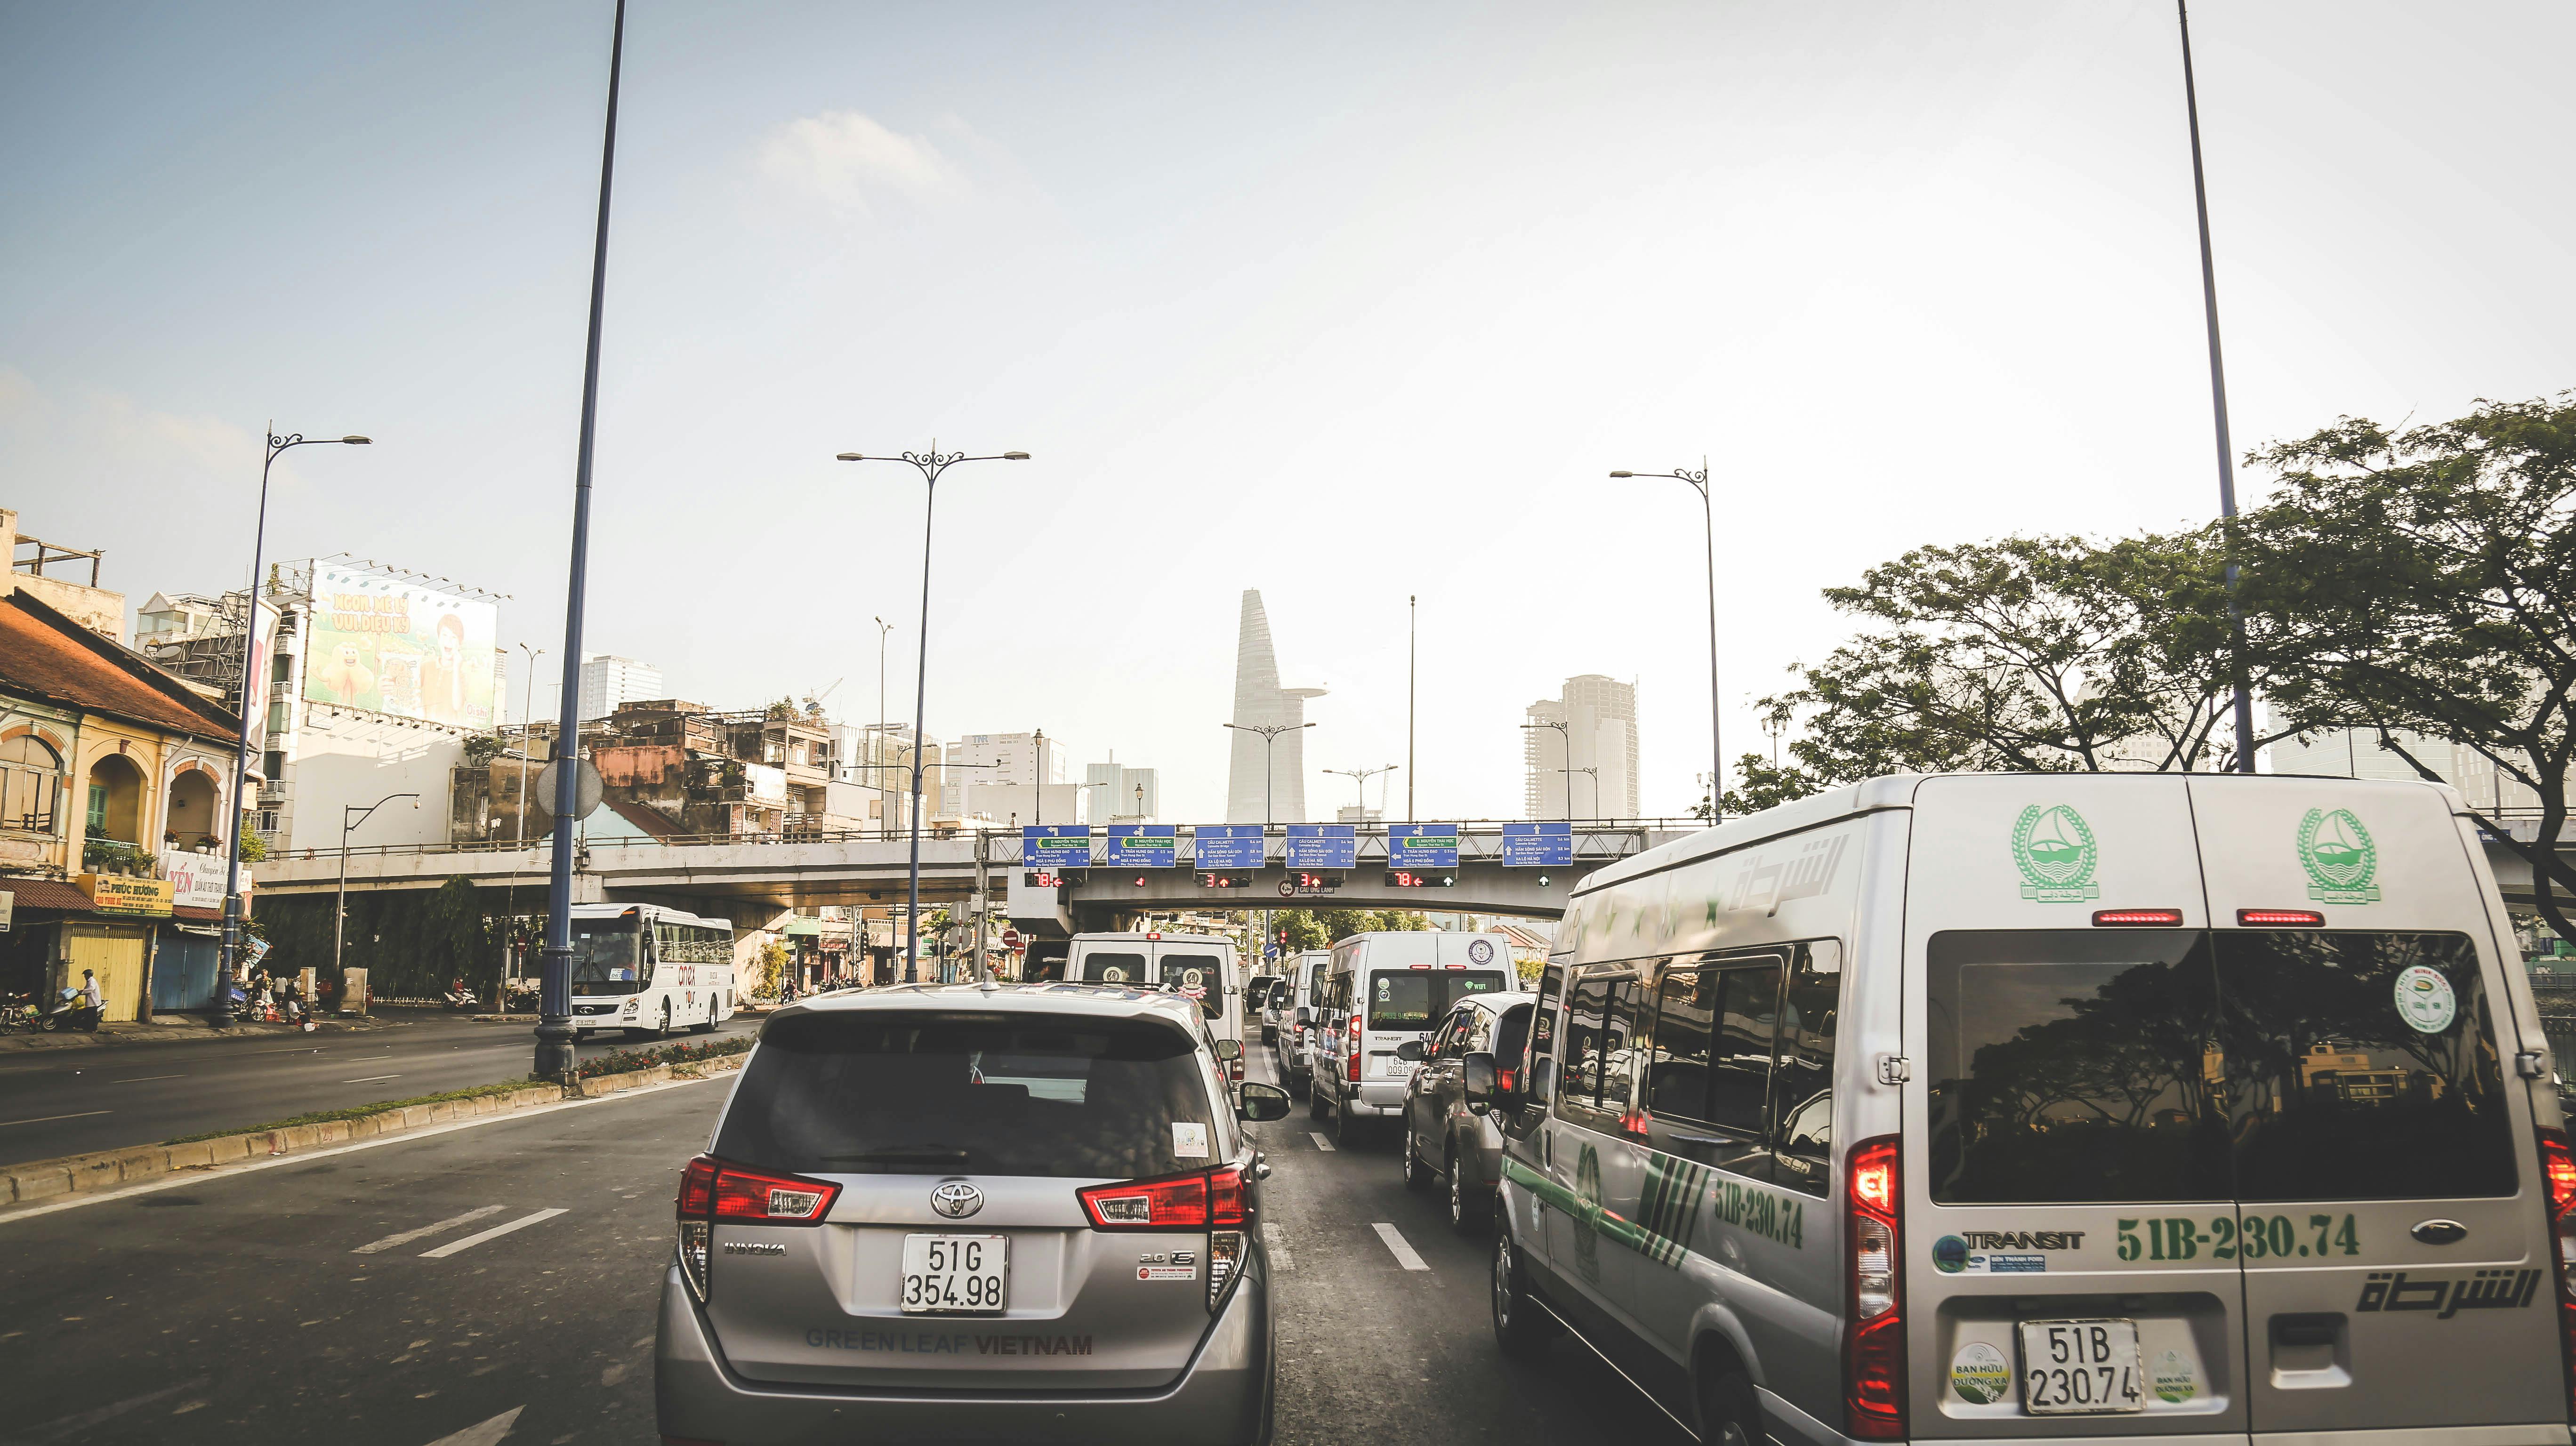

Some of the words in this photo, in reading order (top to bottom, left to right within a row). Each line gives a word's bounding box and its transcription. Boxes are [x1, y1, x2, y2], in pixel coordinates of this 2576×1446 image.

[333, 593, 371, 612] NGON
[332, 613, 360, 632] VUI
[467, 704, 488, 717] Oishi
[111, 883, 131, 894] PHÚC
[1034, 874, 1049, 887] 78
[1207, 874, 1215, 887] 3
[1301, 874, 1309, 886] 3
[1394, 873, 1410, 886] 78
[1388, 1066, 1413, 1074] 009.09
[1715, 1176, 1803, 1250] 51B-230.74
[1962, 1231, 2085, 1250] TRANSIT
[2117, 1213, 2361, 1261] 51B-230.74
[724, 1242, 787, 1256] INNOVA
[929, 1241, 982, 1271] 51G
[906, 1275, 1001, 1306] 354.98
[2355, 1269, 2542, 1320] الشرطة
[805, 1328, 894, 1351] GREEN
[901, 1333, 968, 1354] LEAF
[974, 1334, 1093, 1356] VIETNAM
[2049, 1326, 2110, 1364] 51B
[1956, 1366, 1977, 1375] BẠN
[1953, 1376, 1992, 1386] ĐƯỜNG
[1994, 1377, 2008, 1385] XA
[2030, 1366, 2140, 1406] 230.74
